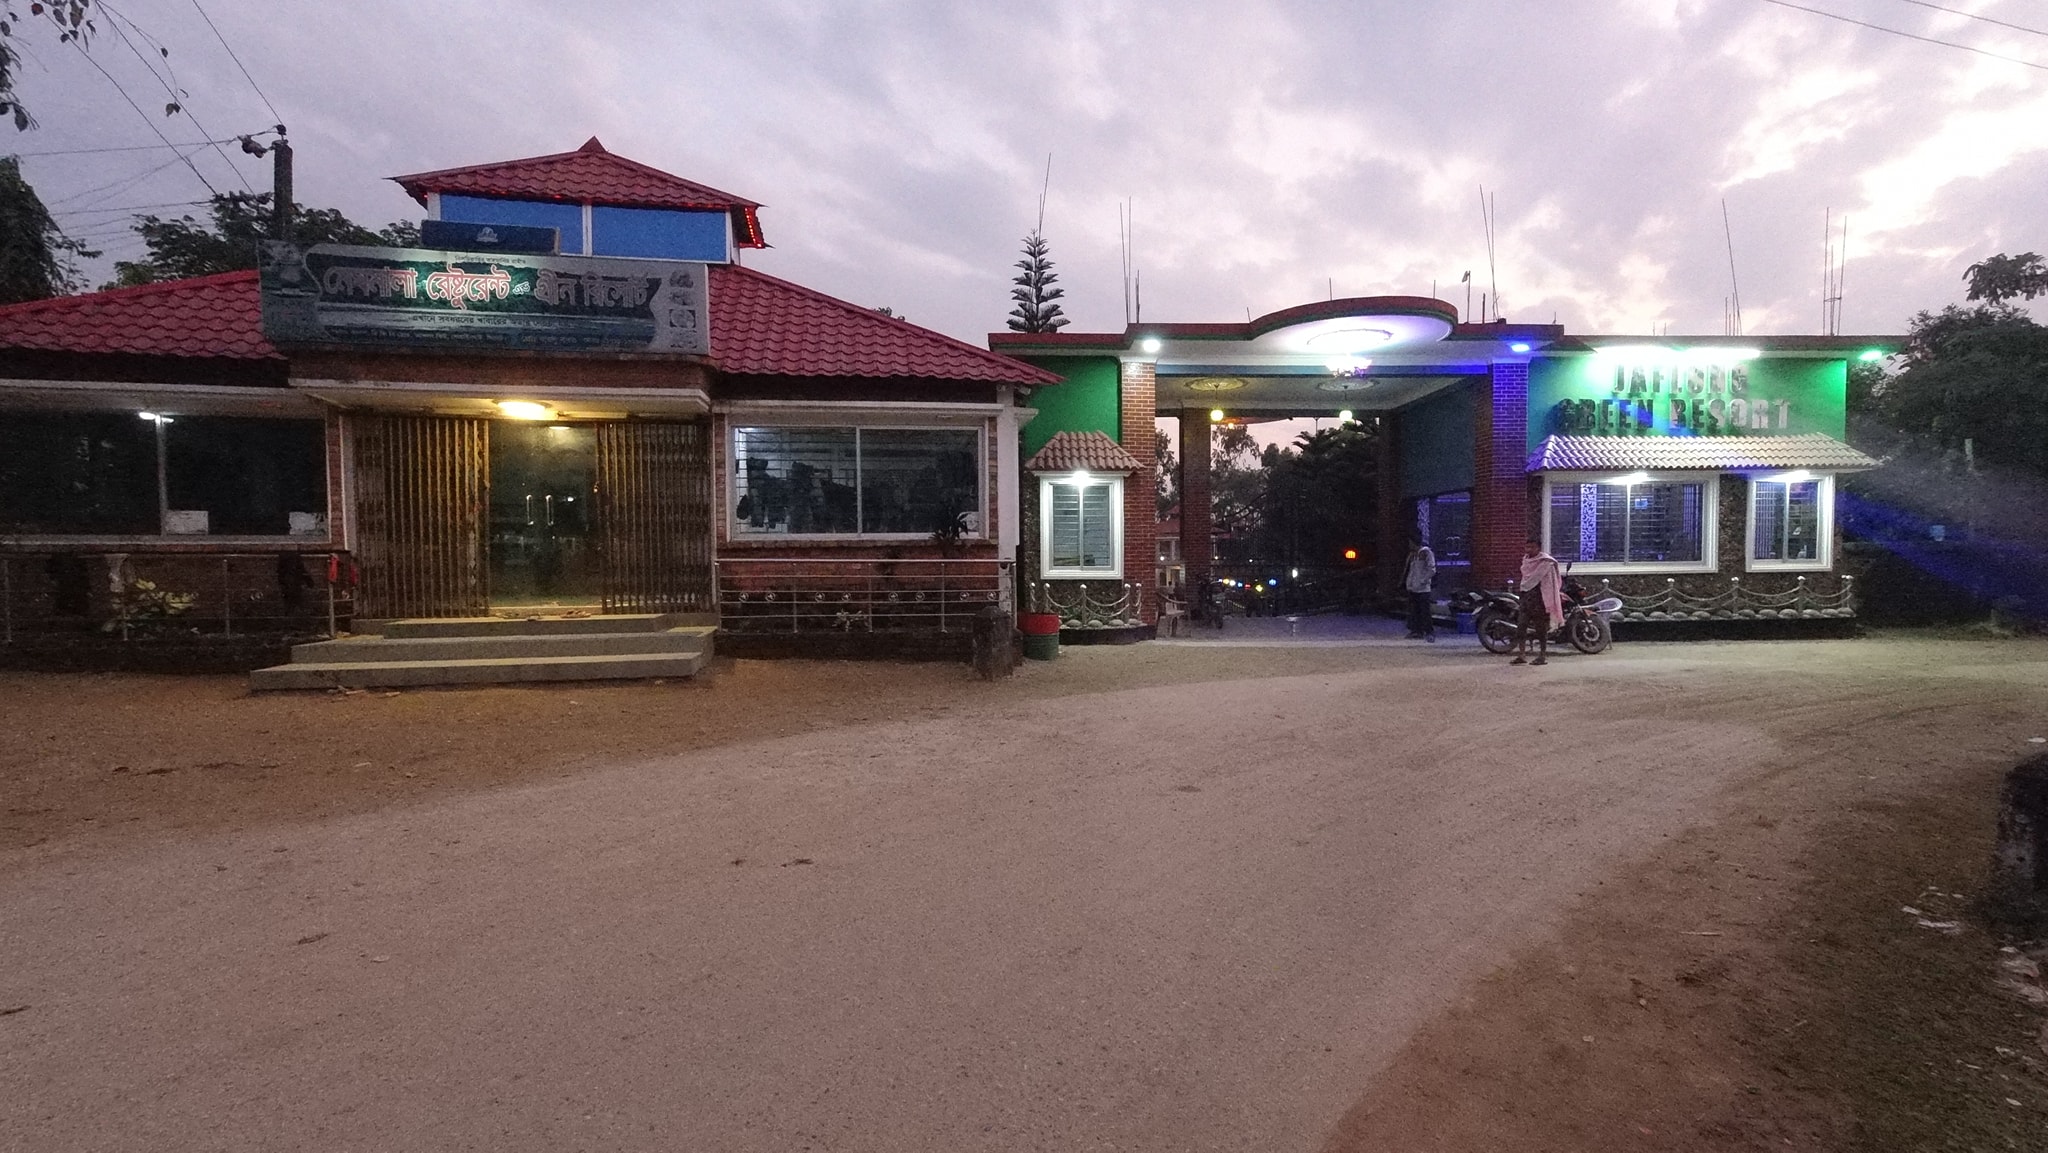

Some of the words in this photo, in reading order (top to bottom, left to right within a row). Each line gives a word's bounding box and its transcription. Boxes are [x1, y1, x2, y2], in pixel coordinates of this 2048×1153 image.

[425, 262, 512, 310] রেষ্টুরেন্ট
[534, 267, 578, 306] গ্রীন
[1558, 398, 1654, 429] GREEN
[1670, 398, 1791, 429] RESORT
